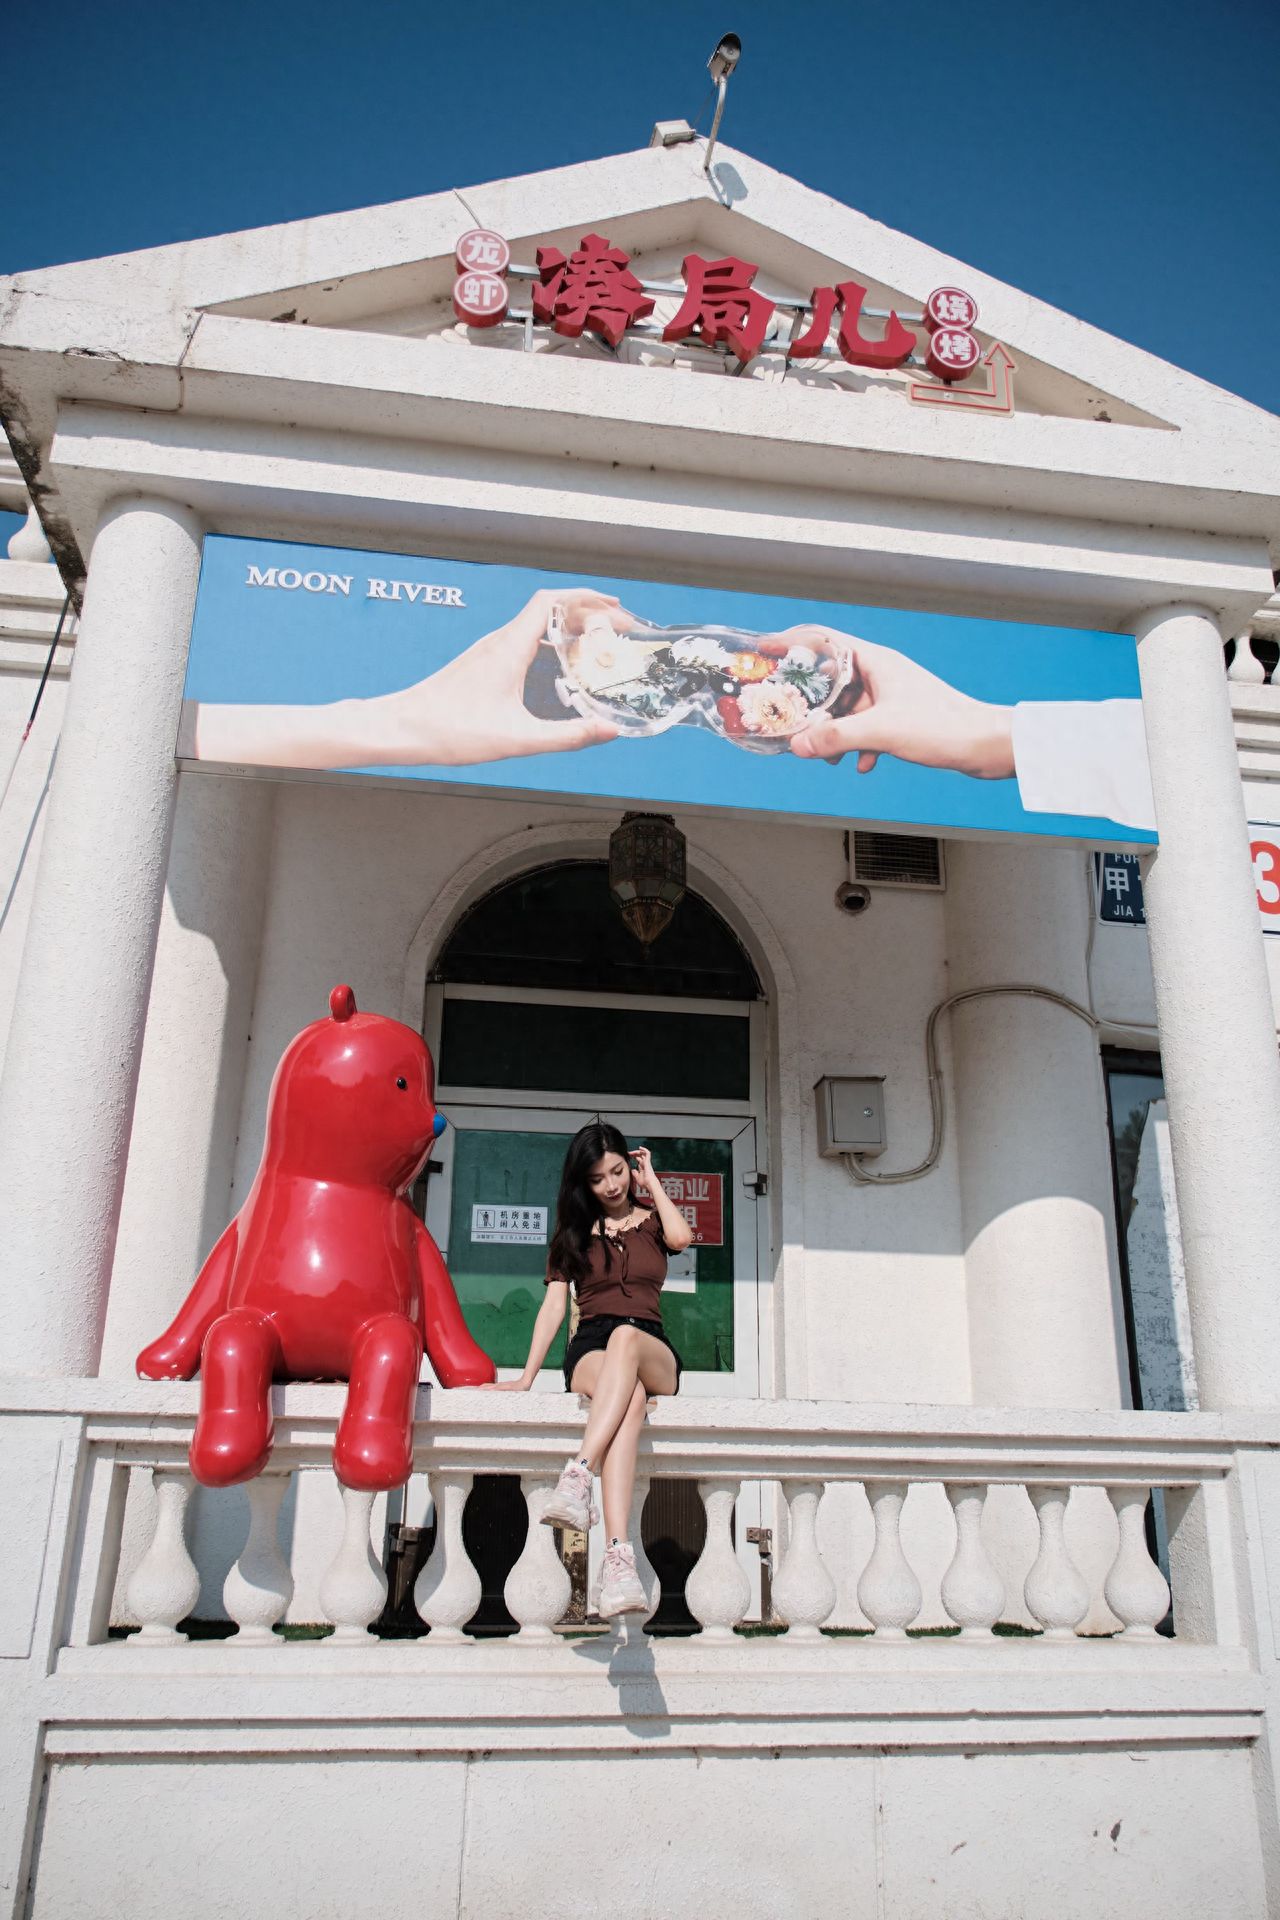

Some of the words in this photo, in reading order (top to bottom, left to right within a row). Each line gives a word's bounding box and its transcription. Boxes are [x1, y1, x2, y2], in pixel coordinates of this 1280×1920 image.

[463, 235, 501, 306] 龙虾
[937, 293, 971, 361] 烧烤
[245, 565, 354, 597] MOON
[366, 578, 467, 608] RIVER
[1113, 904, 1134, 917] JIA
[500, 1210, 541, 1220] 机房重地
[500, 1220, 541, 1230] 闲人免进
